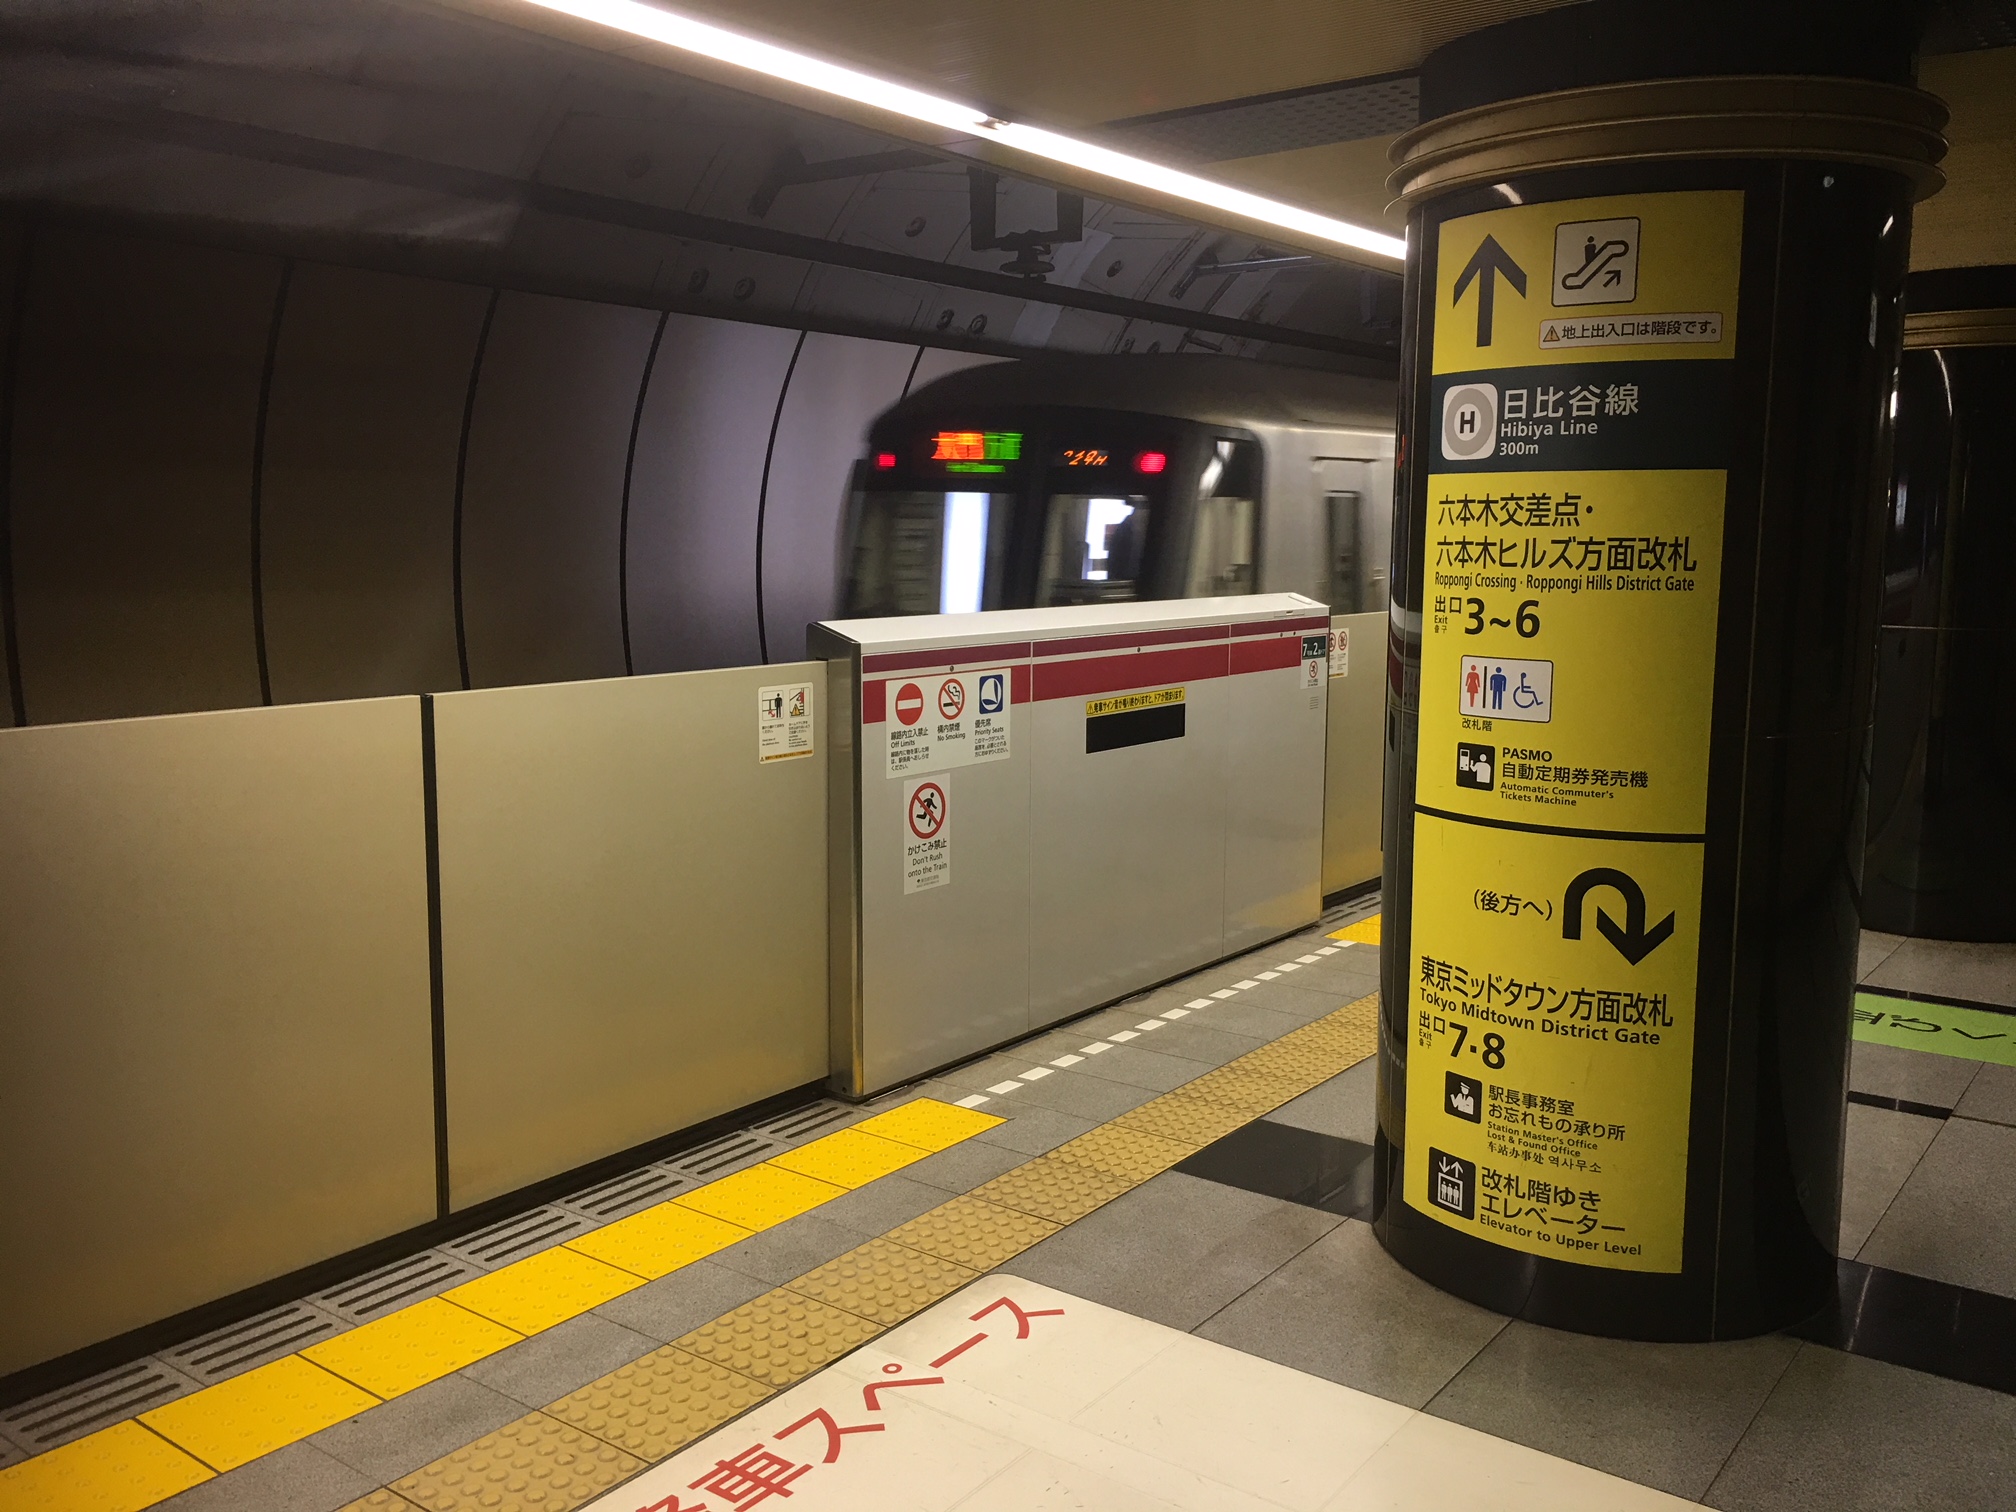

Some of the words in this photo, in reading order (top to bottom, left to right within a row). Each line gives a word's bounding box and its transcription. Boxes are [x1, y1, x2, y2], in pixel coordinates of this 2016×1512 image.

[1562, 320, 1718, 340] 地上出入口は階段です。
[1503, 383, 1640, 420] 日比谷線
[1459, 411, 1476, 434] H
[1500, 420, 1553, 440] Hibiya
[1560, 419, 1598, 436] Line
[1499, 442, 1539, 456] 300m
[1436, 535, 1697, 572] 六本木ヒルズ方面改札
[1434, 572, 1473, 591] Roppongi
[1475, 572, 1517, 592] Crossing
[1526, 574, 1583, 594] Roppongi
[1586, 573, 1613, 591] Hills
[1616, 575, 1661, 591] District
[1665, 576, 1695, 591] Gate
[1434, 595, 1462, 614] 出口
[1434, 615, 1448, 624] Exit
[1461, 718, 1493, 732] 改札階
[890, 741, 900, 749] Off
[901, 739, 915, 748] Limits
[945, 732, 966, 742] Smoking
[1502, 747, 1552, 762] PASMO
[1502, 762, 1649, 789] 自動定期券発売機
[1500, 781, 1549, 795] Automatic
[1552, 785, 1614, 799] Commuter's
[1500, 791, 1531, 802] Tickets
[1534, 794, 1577, 807] Machine
[907, 868, 921, 878] onto
[922, 865, 932, 874] the
[933, 861, 947, 872] Train
[912, 855, 928, 867] Don't
[929, 851, 943, 863] Rush
[1474, 889, 1553, 921] (後方へ)
[1420, 955, 1674, 1028] 東京ミッドタウン方面改札
[1419, 1010, 1445, 1035] 出口
[1420, 987, 1457, 1013] Tokyo
[1461, 1001, 1535, 1030] Midtown
[1541, 1018, 1609, 1041] District
[1614, 1027, 1661, 1045] Gate
[1418, 1028, 1432, 1041] Exit
[1488, 1084, 1575, 1117] 駅長事務室
[1488, 1103, 1626, 1142] お忘れもの承り所
[1487, 1121, 1520, 1137] Station
[1522, 1128, 1564, 1145] Master's
[1567, 1138, 1598, 1150] Office
[1487, 1131, 1506, 1142] Lost
[1508, 1135, 1515, 1144] &
[1518, 1138, 1547, 1151] Found
[1550, 1145, 1581, 1157] Office
[1481, 1166, 1602, 1213] 改札階ゆき
[1480, 1193, 1626, 1235] エレベーター
[1480, 1213, 1532, 1238] Elevator
[1537, 1230, 1551, 1242] to
[1556, 1233, 1599, 1251] Upper
[1603, 1241, 1642, 1255] Level
